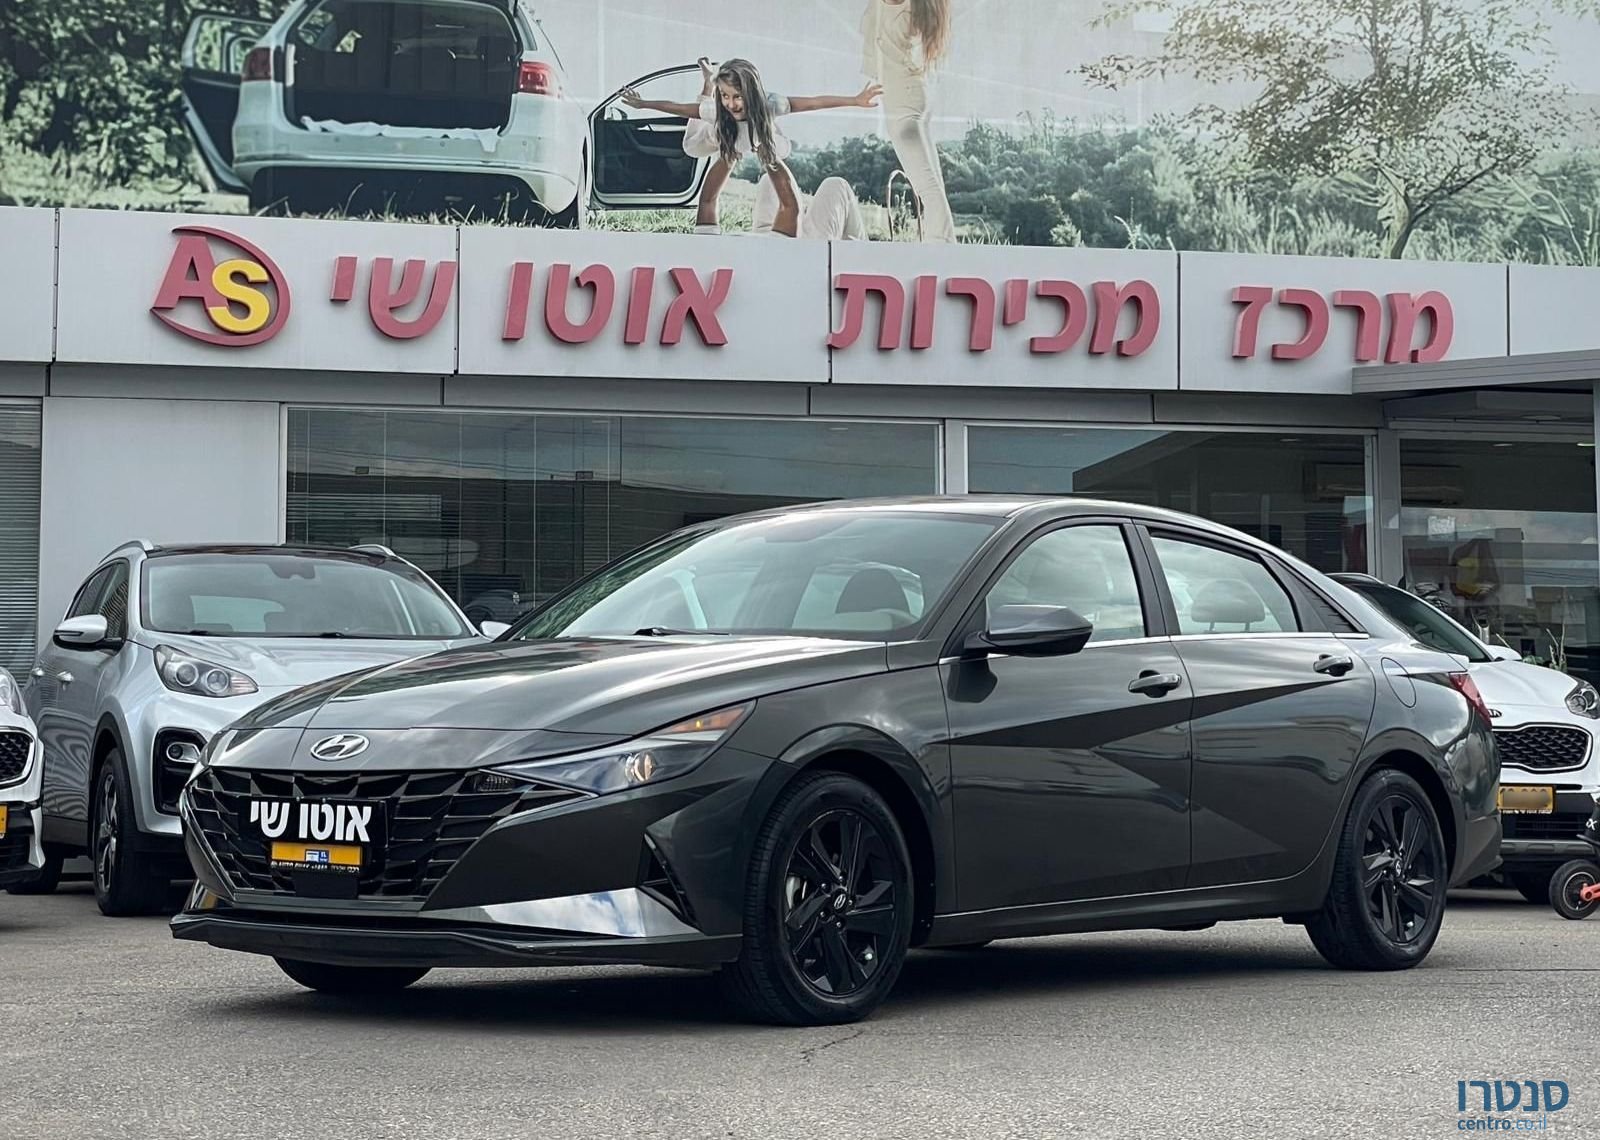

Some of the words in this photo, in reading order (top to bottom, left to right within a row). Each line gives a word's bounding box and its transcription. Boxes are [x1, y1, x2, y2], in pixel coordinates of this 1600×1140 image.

[152, 235, 270, 334] AS
[330, 255, 457, 340] שי
[502, 262, 734, 346] אוטו
[827, 272, 1161, 357] מכירות
[1233, 285, 1454, 363] מרכז
[250, 800, 290, 838] שי
[299, 803, 372, 842] אוטו
